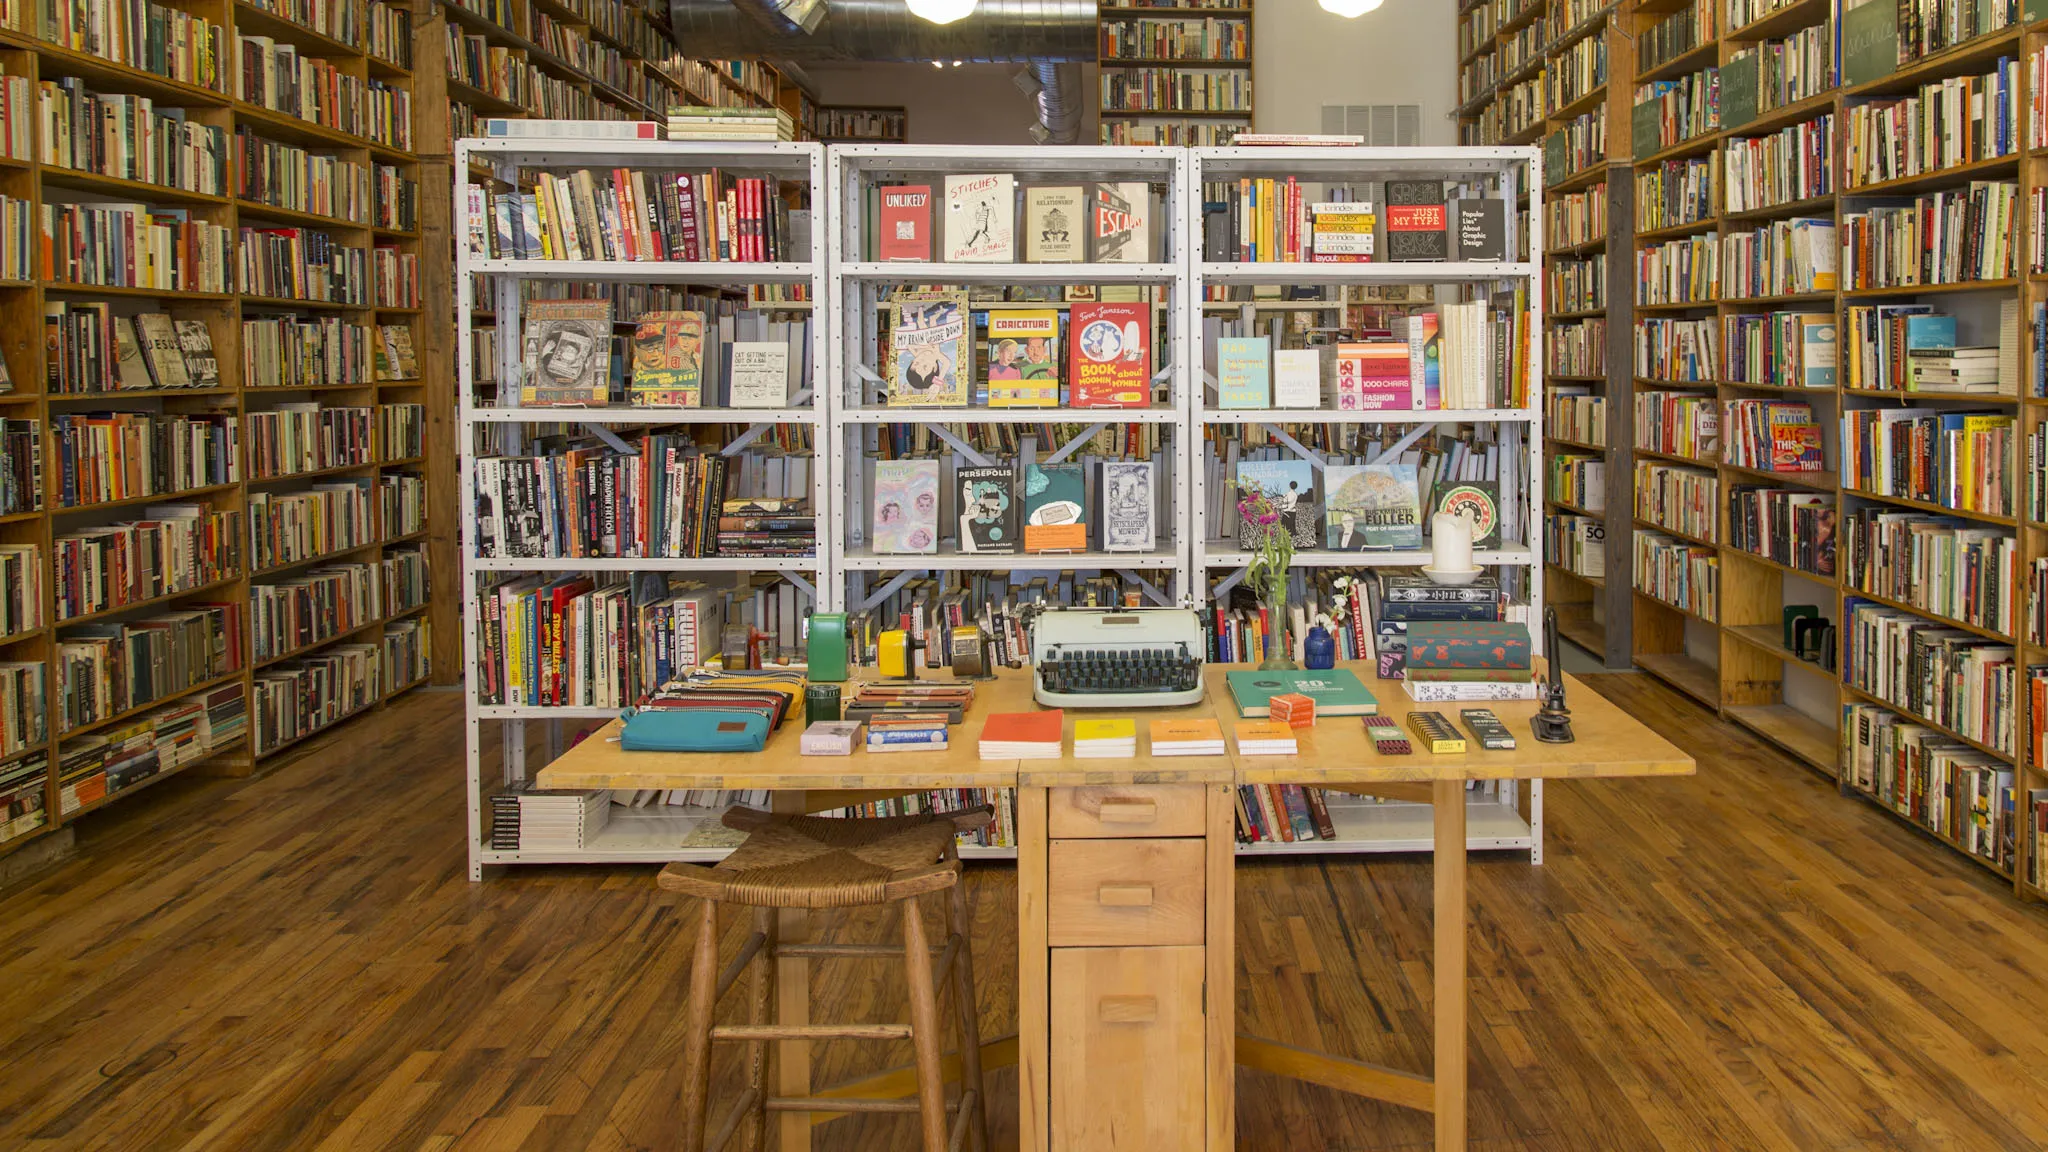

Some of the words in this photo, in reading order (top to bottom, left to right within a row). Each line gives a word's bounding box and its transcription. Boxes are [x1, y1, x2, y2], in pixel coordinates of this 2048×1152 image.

[950, 176, 999, 199] STITCHES
[886, 194, 927, 208] UNLIKELY
[648, 203, 657, 223] LUST
[1319, 214, 1358, 222] ideaindex
[1413, 208, 1439, 217] JUST
[1462, 211, 1484, 219] Popular
[1393, 217, 1410, 226] MY
[1412, 216, 1440, 225] TYPE
[1462, 224, 1481, 232] About
[1462, 232, 1486, 241] Graphic
[1463, 239, 1483, 247] Design
[954, 248, 978, 259] DAVID
[982, 242, 1007, 253] SMALL
[1315, 255, 1357, 263] layoutindex
[1079, 311, 1096, 321] Tove
[1097, 306, 1135, 318] Jansson
[995, 320, 1050, 329] CARICATURE
[897, 335, 907, 345] MY
[908, 334, 924, 345] BRAIN
[945, 325, 961, 338] DOWN
[180, 335, 212, 351] GHOST
[185, 358, 218, 374] WALTZ
[1080, 364, 1117, 377] BOOK
[1117, 367, 1144, 378] about
[1363, 380, 1382, 388] 1000
[1382, 380, 1409, 388] CHAIRS
[1363, 394, 1396, 402] FASHION
[1363, 401, 1382, 409] NOW
[1774, 415, 1808, 424] ATKINS
[1970, 415, 1984, 425] the
[1777, 428, 1798, 441] EAT
[1776, 440, 1797, 451] THIS
[1240, 462, 1277, 470] COLLECT
[1800, 461, 1822, 471] THAT!
[958, 469, 1012, 479] PERSEPOLIS
[588, 466, 597, 496] ESSENTIAL
[604, 475, 613, 505] GRAPHIC
[604, 505, 613, 535] FICTION
[1365, 514, 1414, 525] FULLER
[1118, 528, 1141, 536] MIDWEST
[1586, 527, 1605, 540] 50
[552, 613, 561, 640] STRAY
[1353, 606, 1361, 633] TRAVEL
[1357, 634, 1365, 658] ITALIA
[658, 631, 666, 660] SUPERMAN
[552, 640, 561, 674] BULLETS
